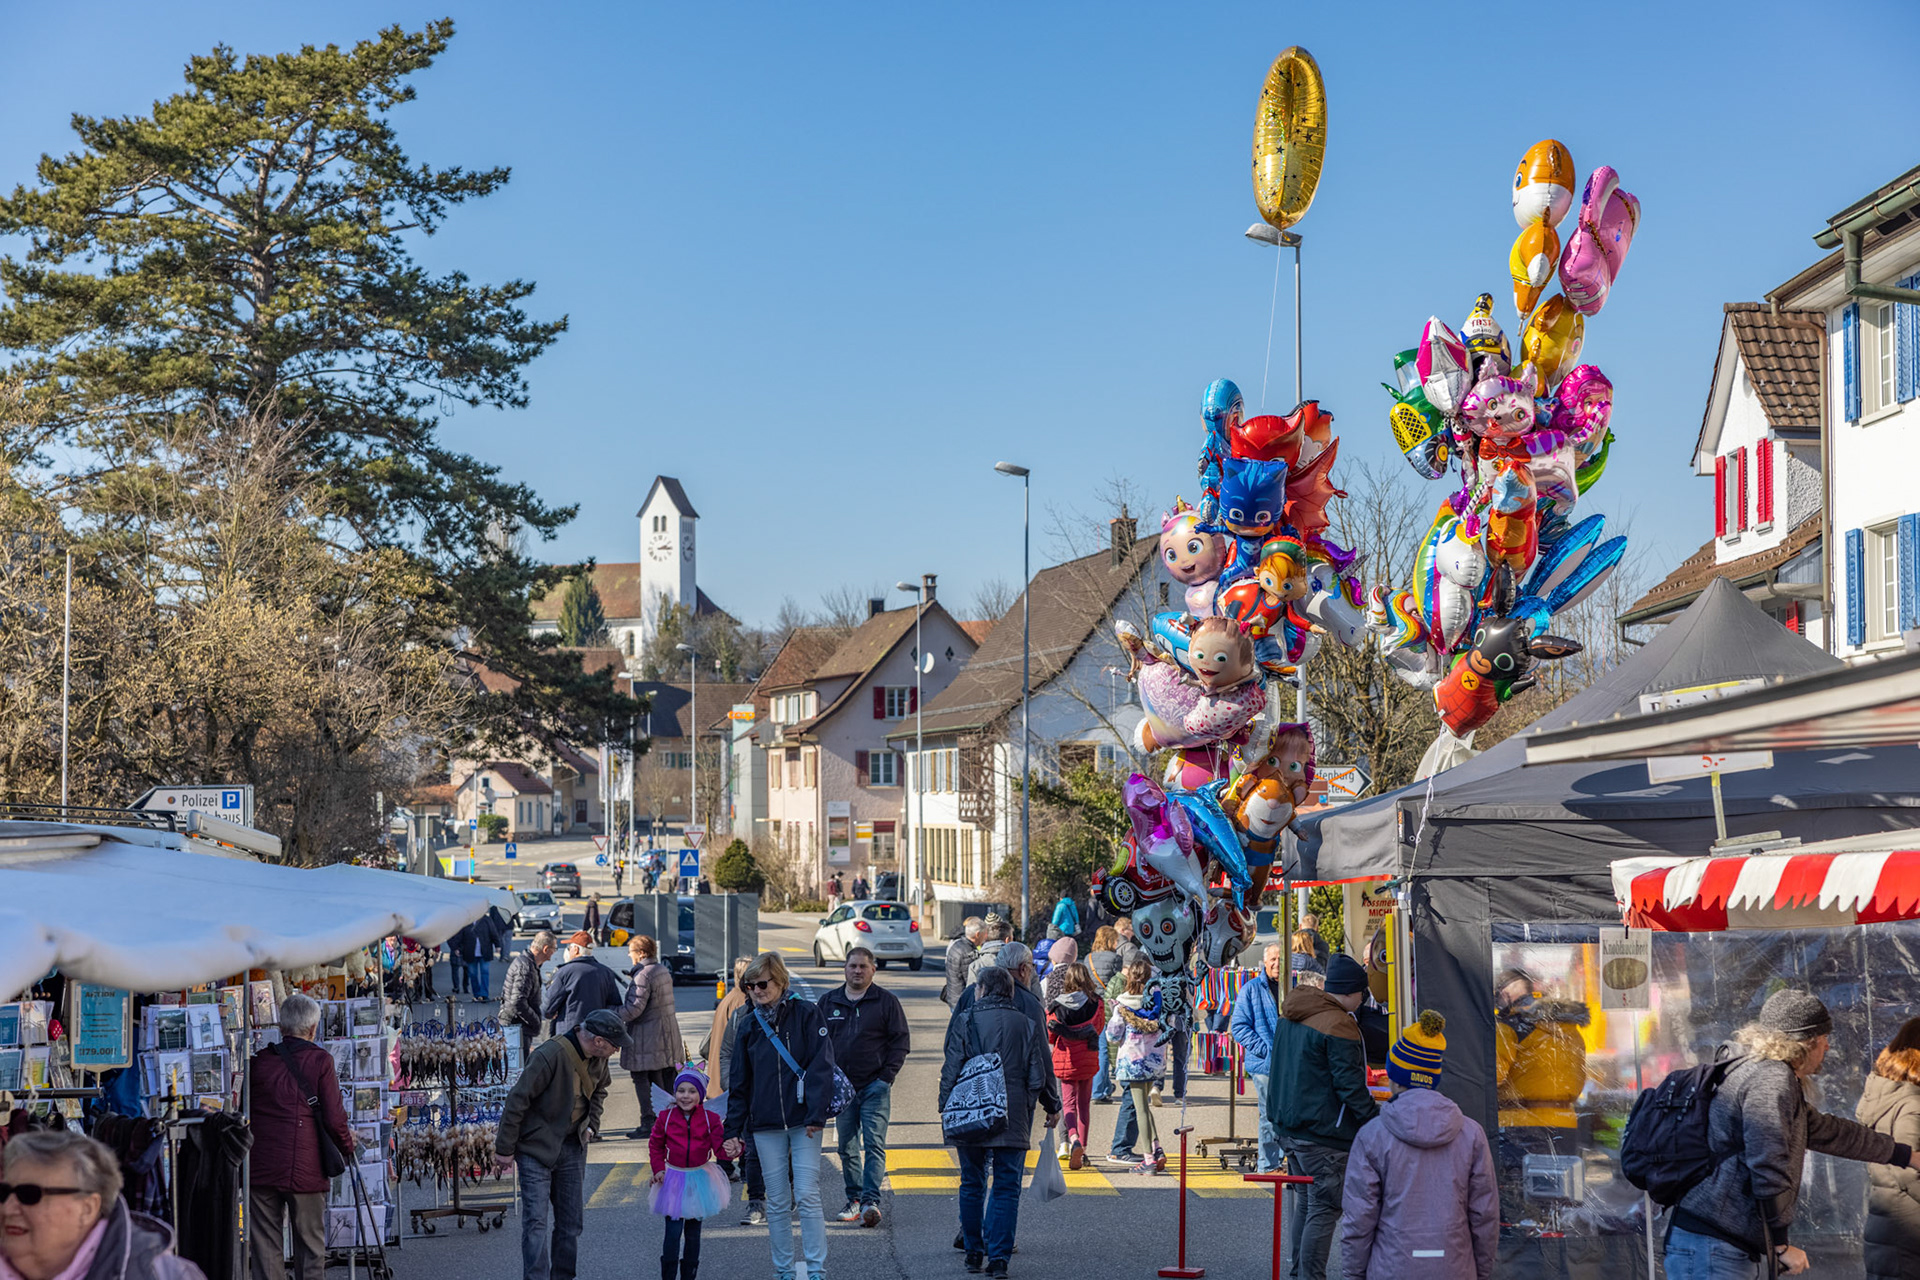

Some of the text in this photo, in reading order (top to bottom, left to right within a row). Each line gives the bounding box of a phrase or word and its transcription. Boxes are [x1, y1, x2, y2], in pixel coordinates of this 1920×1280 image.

[727, 711, 755, 721] coop
[182, 793, 218, 807] Polizei
[1410, 1072, 1433, 1085] DAVOS
